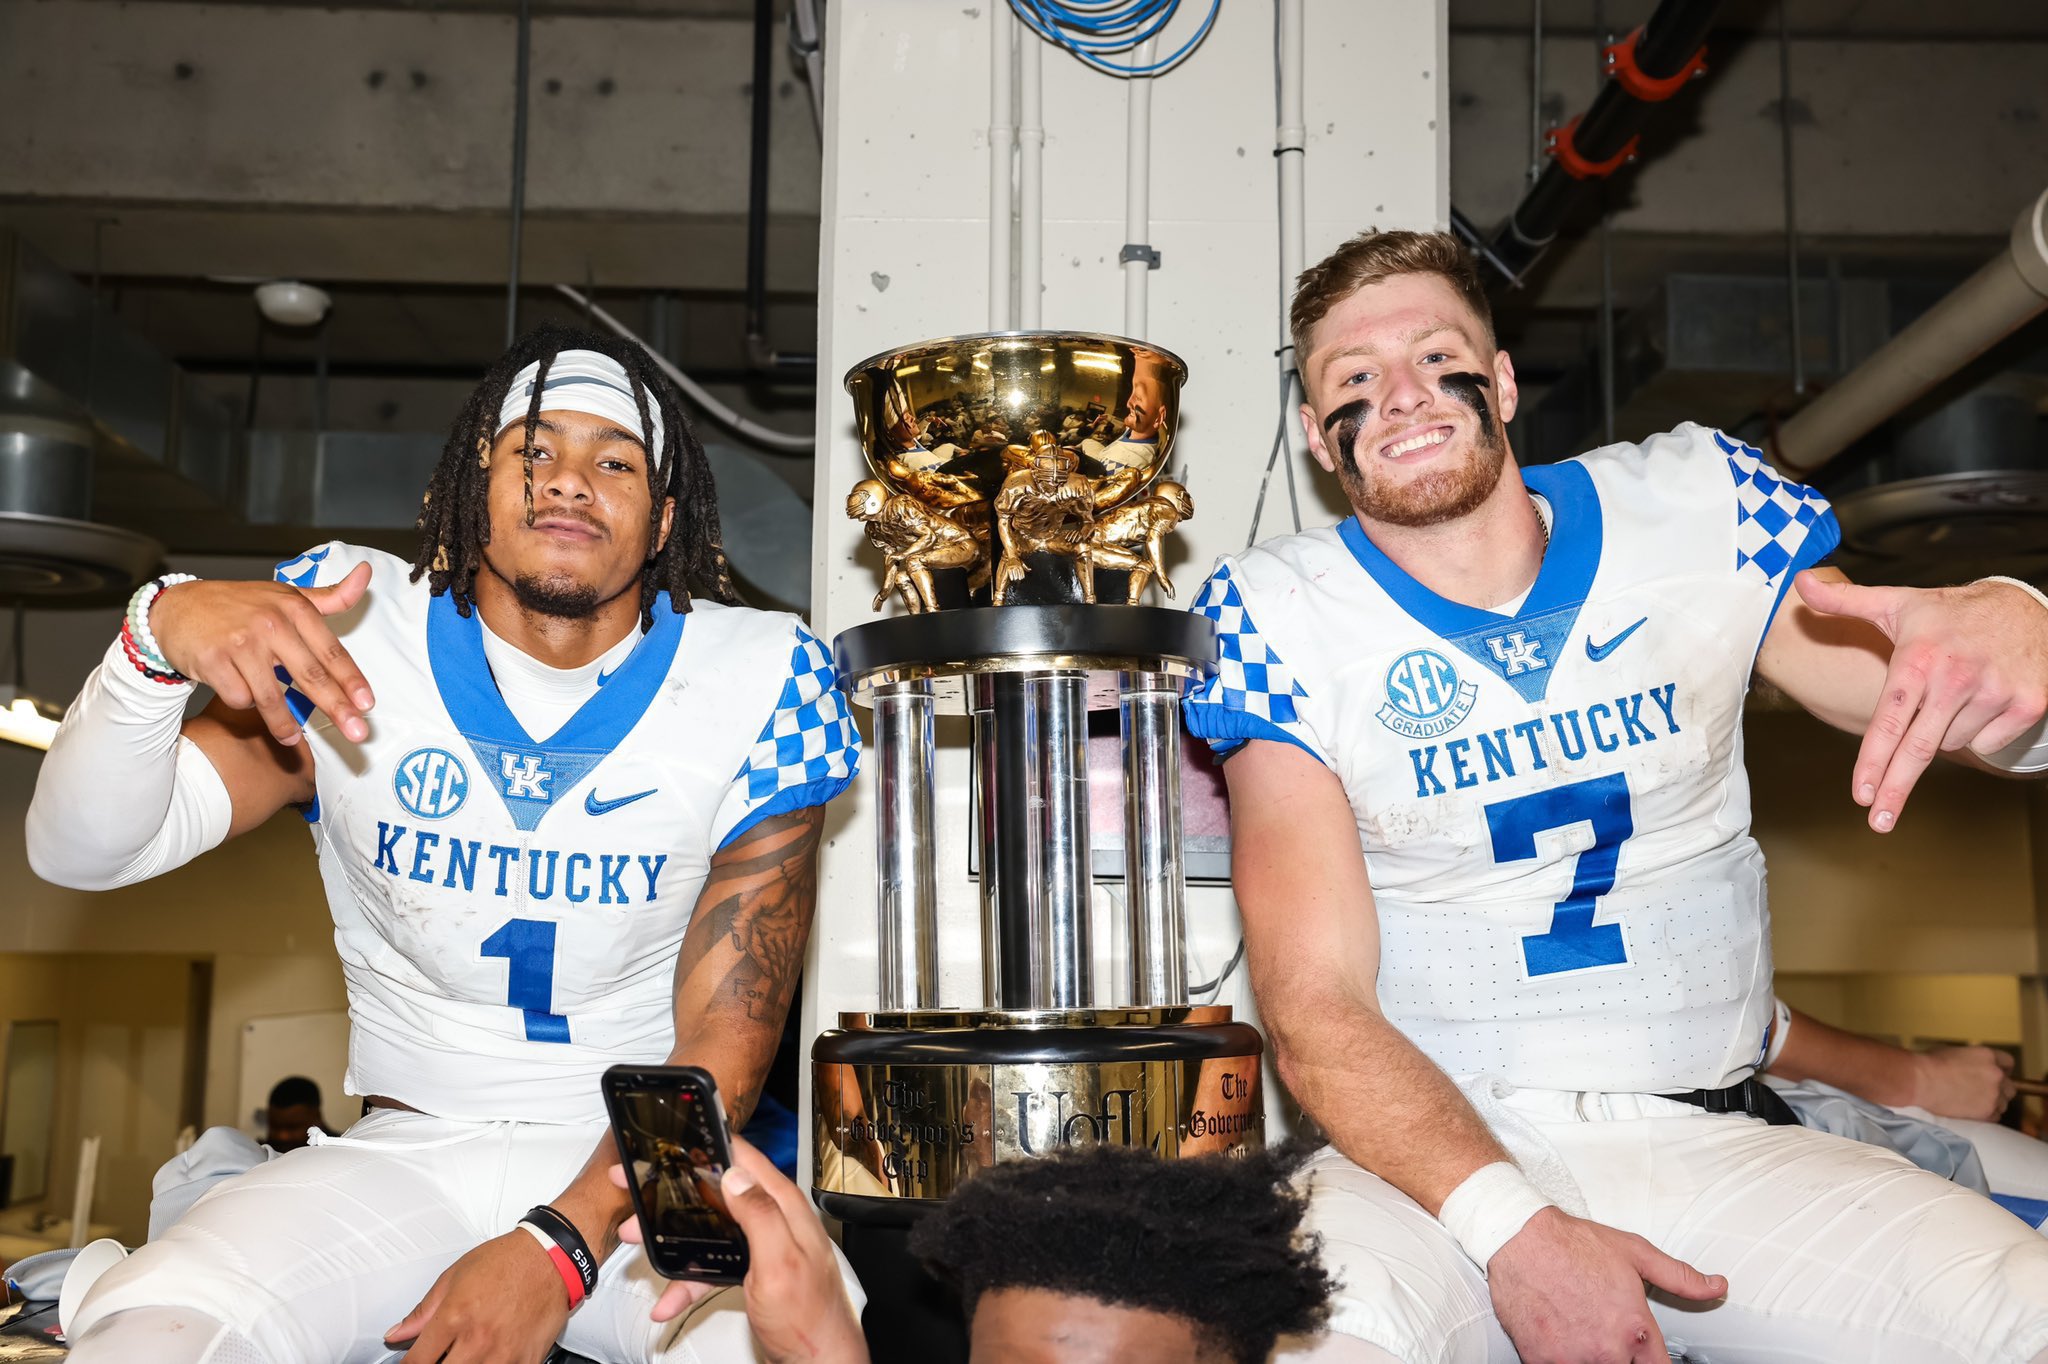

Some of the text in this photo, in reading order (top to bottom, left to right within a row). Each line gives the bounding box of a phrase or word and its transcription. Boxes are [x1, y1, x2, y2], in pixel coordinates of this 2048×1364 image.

[1390, 652, 1453, 716] SEC
[1392, 700, 1469, 737] GRADUATE
[1409, 683, 1681, 797] KENTUCKY
[399, 752, 464, 815] SEC
[374, 821, 668, 904] KENTUCKY
[1484, 771, 1634, 977] 7
[480, 918, 572, 1045] 1
[882, 1080, 926, 1112] The
[1221, 1073, 1248, 1102] The
[883, 1151, 928, 1184] Cup
